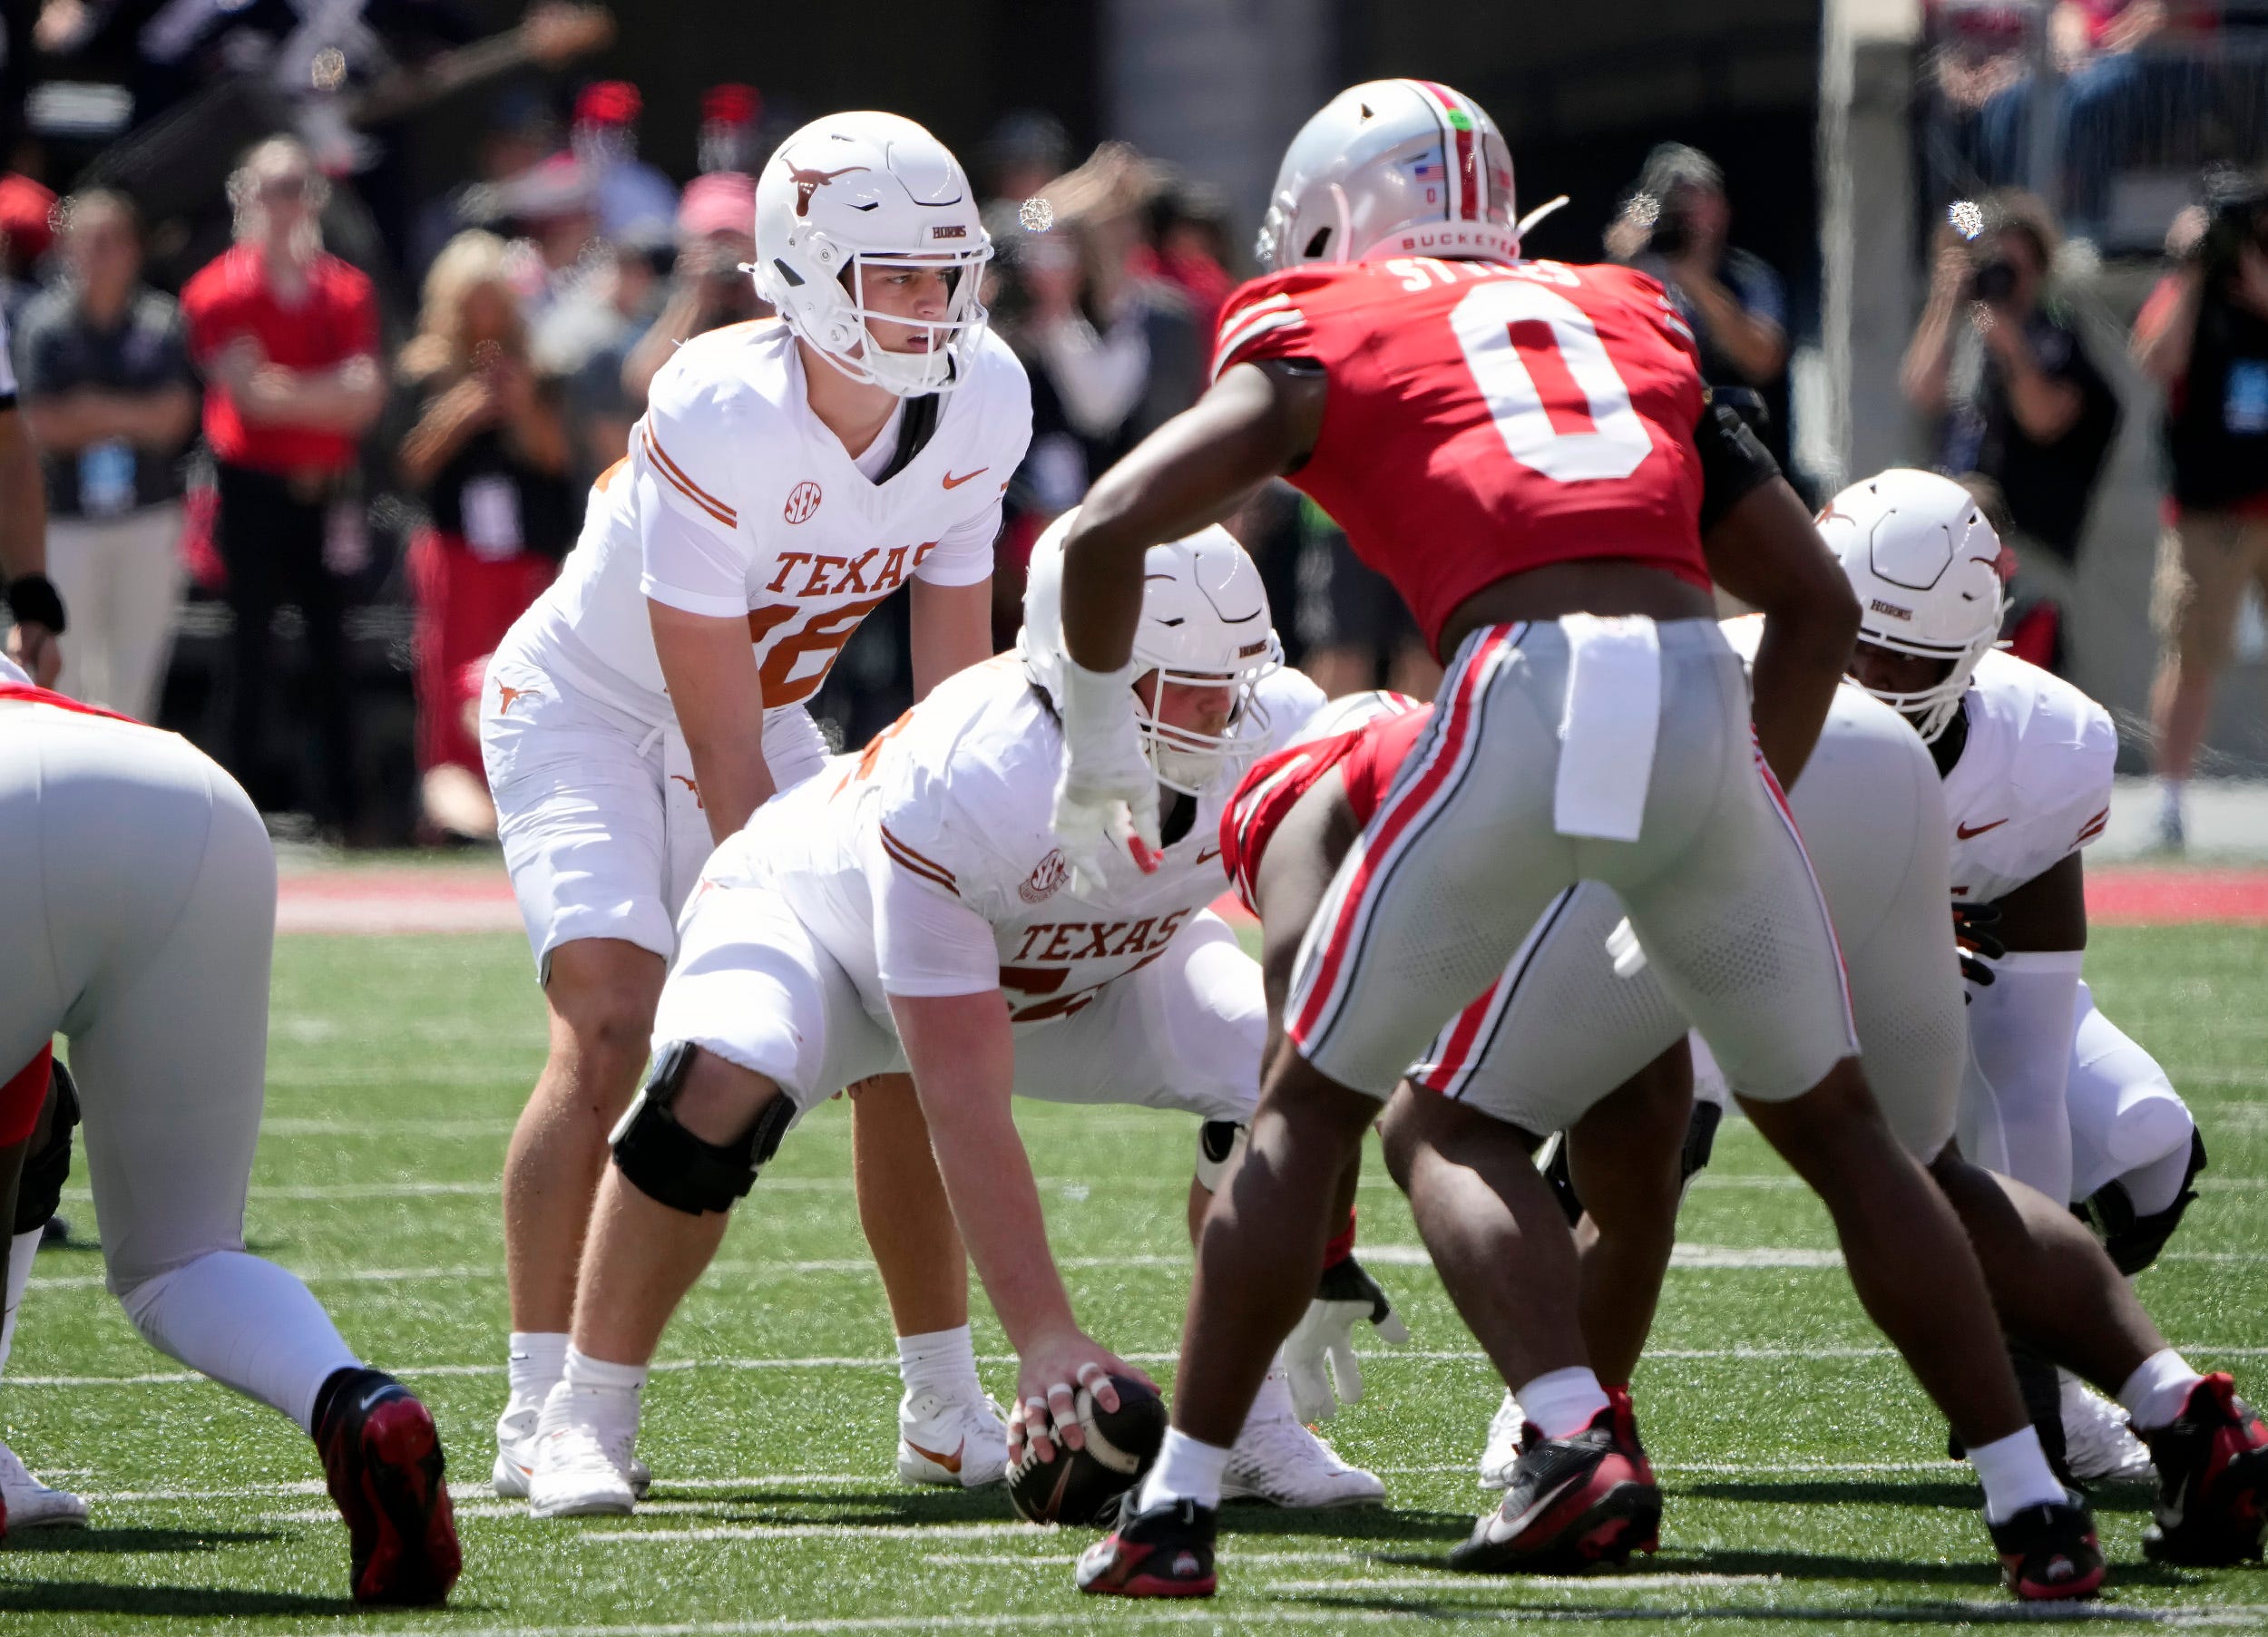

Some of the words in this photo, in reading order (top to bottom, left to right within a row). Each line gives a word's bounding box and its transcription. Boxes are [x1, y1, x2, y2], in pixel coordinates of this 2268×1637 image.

[1426, 188, 1436, 204] 0
[1402, 233, 1516, 258] BUCKEYES
[1449, 280, 1654, 482] 0
[785, 482, 822, 524] SEC
[1012, 907, 1191, 962] TEXAS
